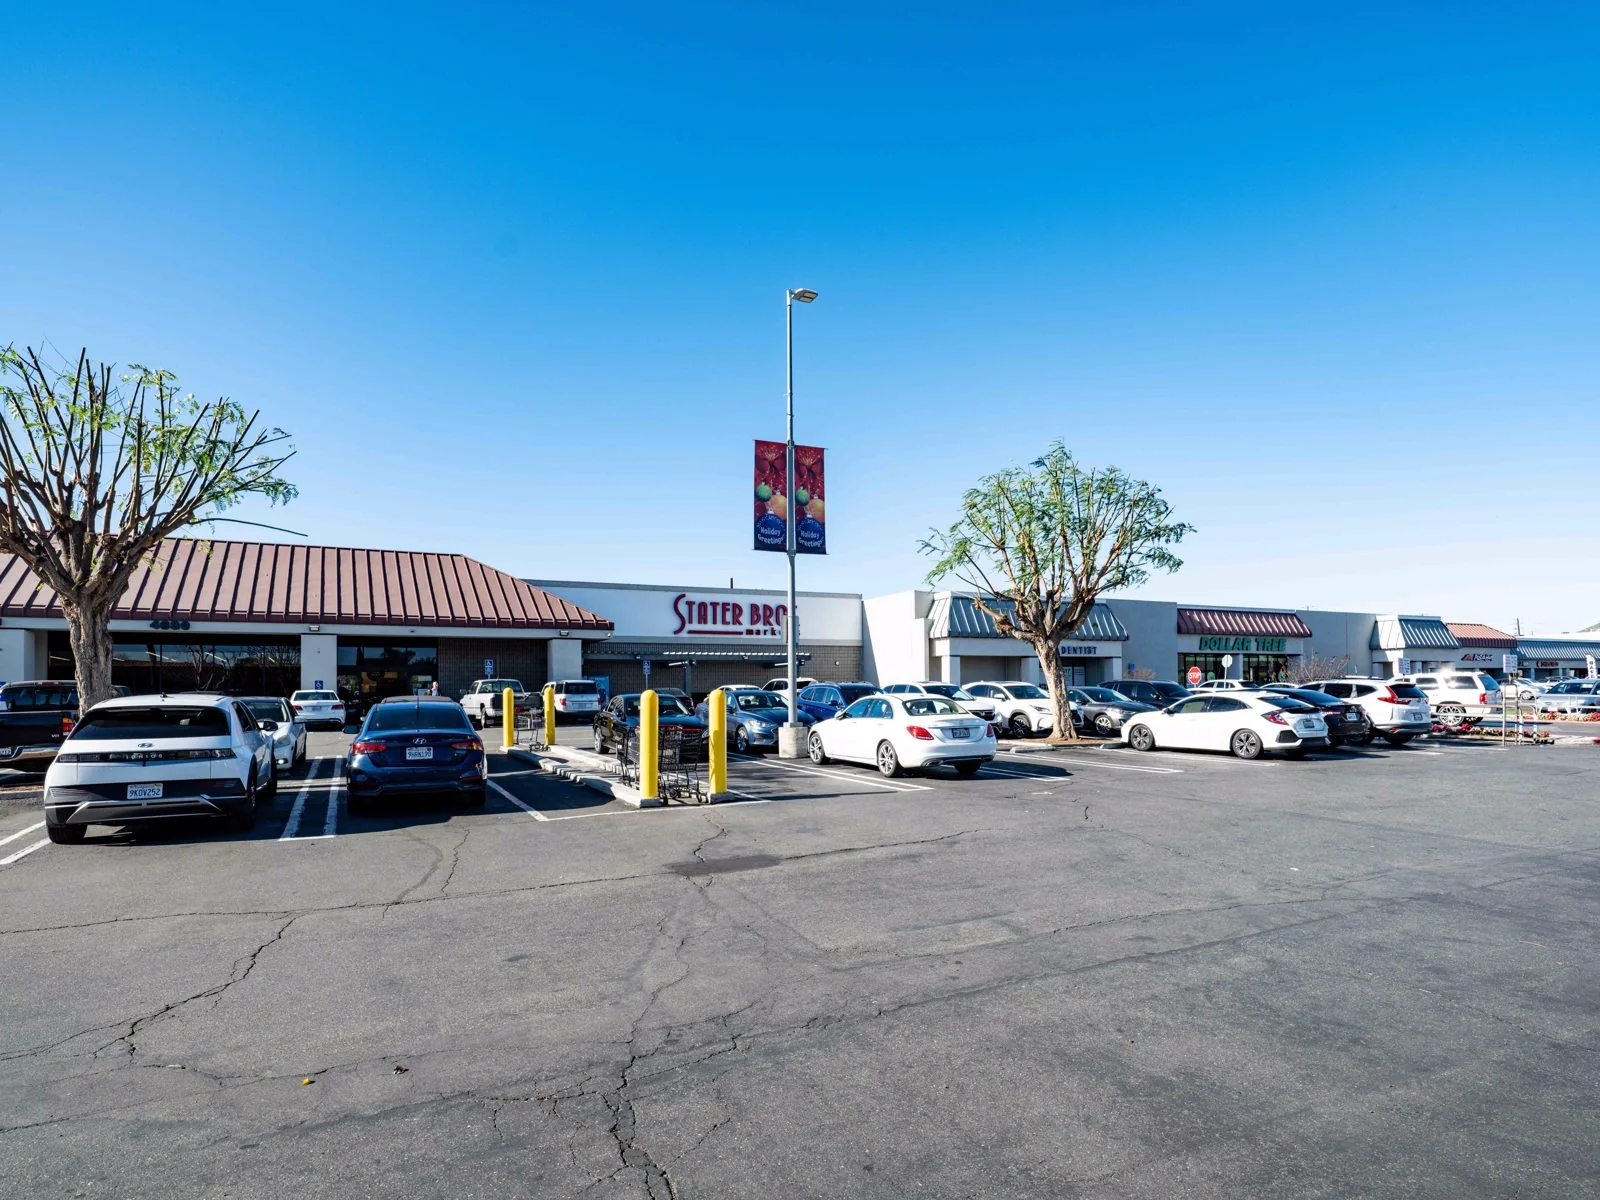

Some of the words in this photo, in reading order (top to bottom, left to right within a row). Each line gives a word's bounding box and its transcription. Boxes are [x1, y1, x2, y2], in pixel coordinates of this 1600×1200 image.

[760, 526, 781, 537] Holiday
[800, 530, 820, 540] Holiday
[673, 593, 744, 635] STATER
[750, 603, 797, 627] BRO
[1199, 636, 1252, 651] DOLLAR
[1255, 638, 1287, 652] TREE
[1061, 646, 1097, 655] DENTIST
[1189, 671, 1202, 679] STOP
